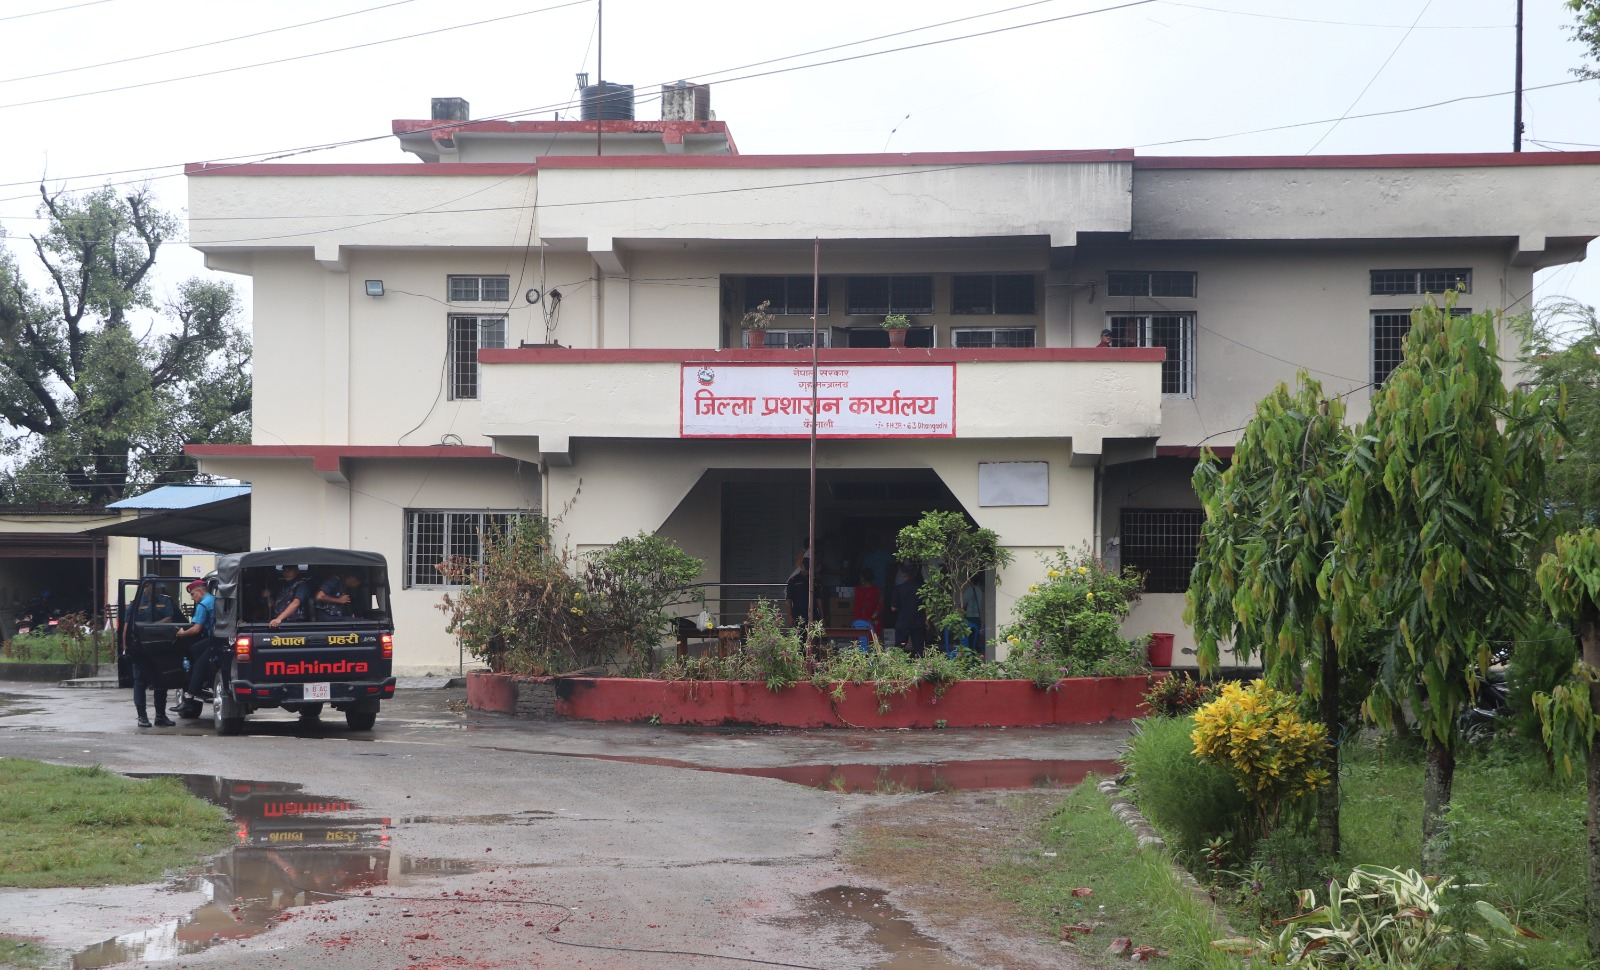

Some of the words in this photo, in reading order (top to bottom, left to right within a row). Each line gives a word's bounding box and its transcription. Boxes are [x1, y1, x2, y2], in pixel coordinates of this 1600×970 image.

[819, 369, 849, 378] सरकार
[694, 388, 756, 416] जिल्ला
[761, 396, 844, 417] प्रशासन
[849, 389, 938, 417] कार्यालय
[271, 635, 306, 647] नेपाल
[327, 632, 360, 645] प्रहरी
[265, 659, 369, 676] Mahindra
